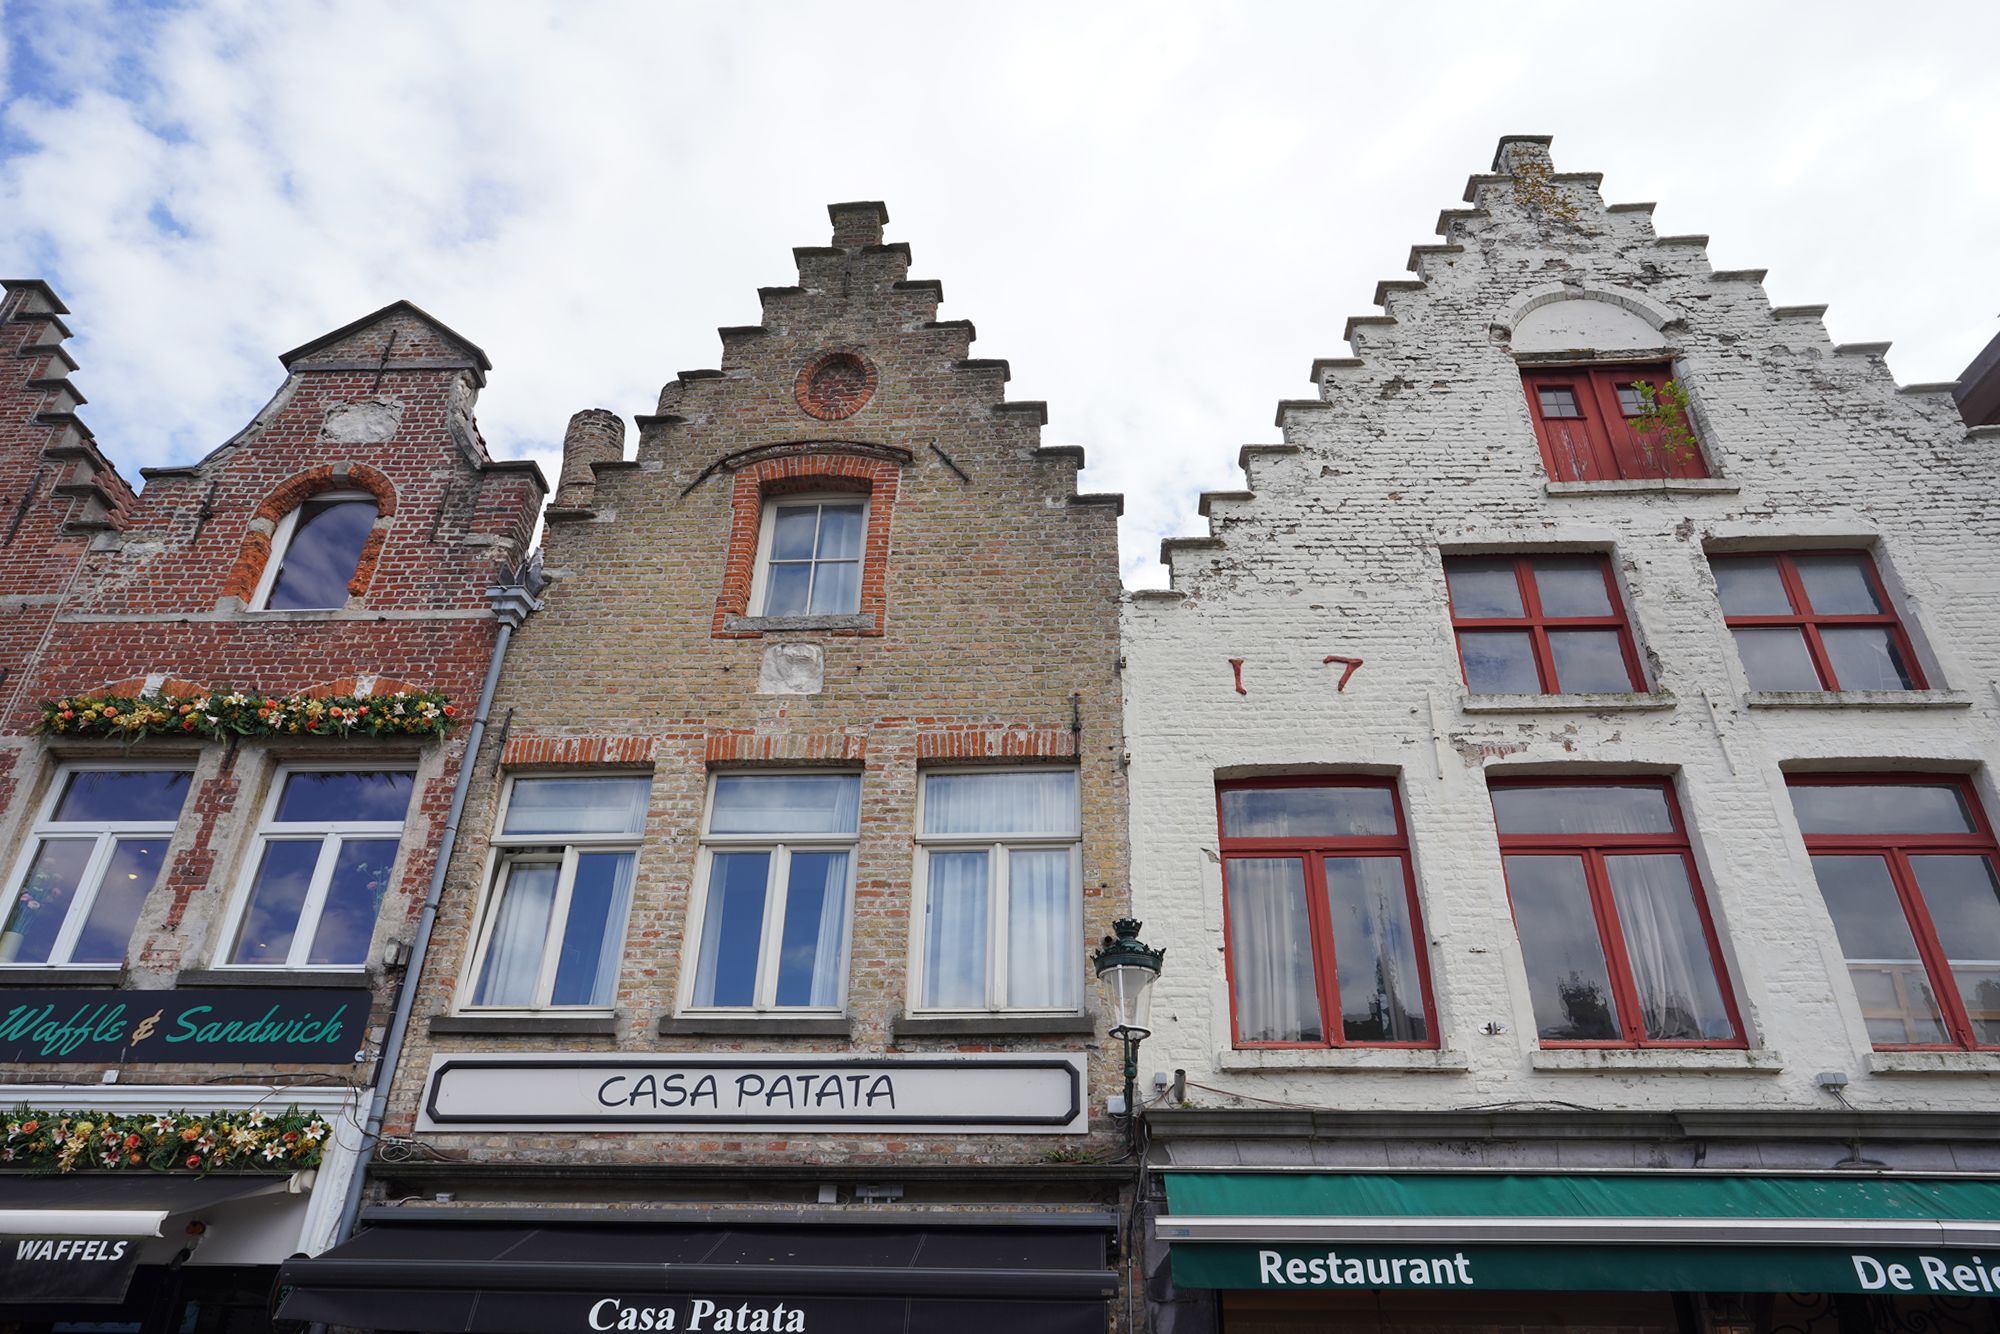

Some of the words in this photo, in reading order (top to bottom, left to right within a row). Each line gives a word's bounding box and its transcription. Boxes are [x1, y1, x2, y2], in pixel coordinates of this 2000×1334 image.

[0, 1003, 128, 1057] Waffle
[131, 1008, 165, 1047] &
[165, 1003, 348, 1044] Sandwich
[597, 1074, 719, 1109] CASA
[734, 1073, 896, 1110] PATATA
[15, 1240, 128, 1261] WAFFELS
[1258, 1250, 1474, 1285] Restaurant
[1850, 1255, 1914, 1291] De
[588, 1298, 676, 1331] Casa
[685, 1299, 806, 1333] Patata
